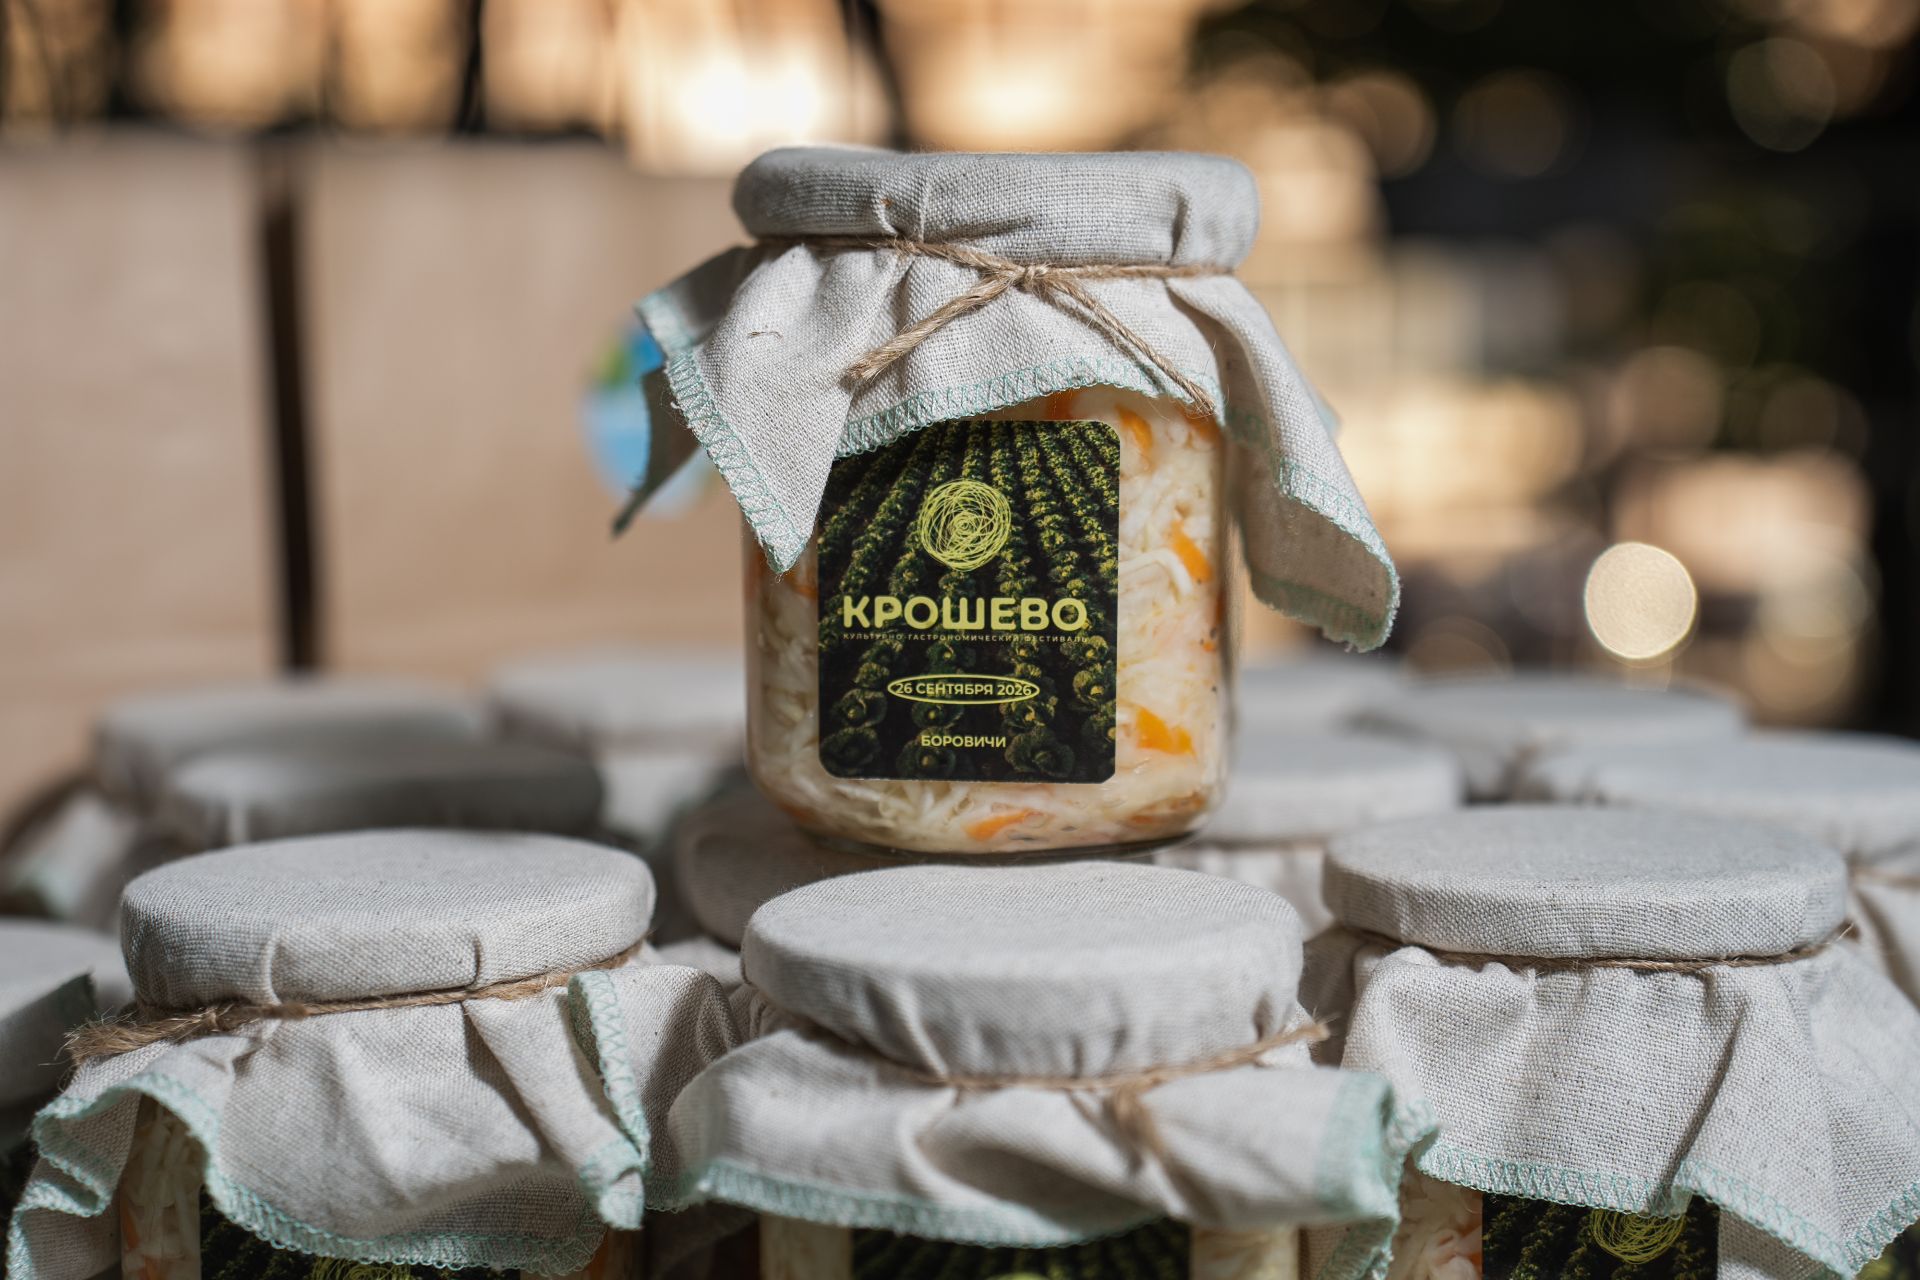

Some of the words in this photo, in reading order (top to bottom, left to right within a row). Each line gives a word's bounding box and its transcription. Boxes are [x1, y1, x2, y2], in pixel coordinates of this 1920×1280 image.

[843, 595, 1087, 631] КРОШЕВО
[896, 683, 913, 695] 26
[916, 683, 993, 696] СЕНТЯБРЯ
[997, 685, 1032, 697] 2026
[921, 735, 1006, 748] БОРОВИЧИ
